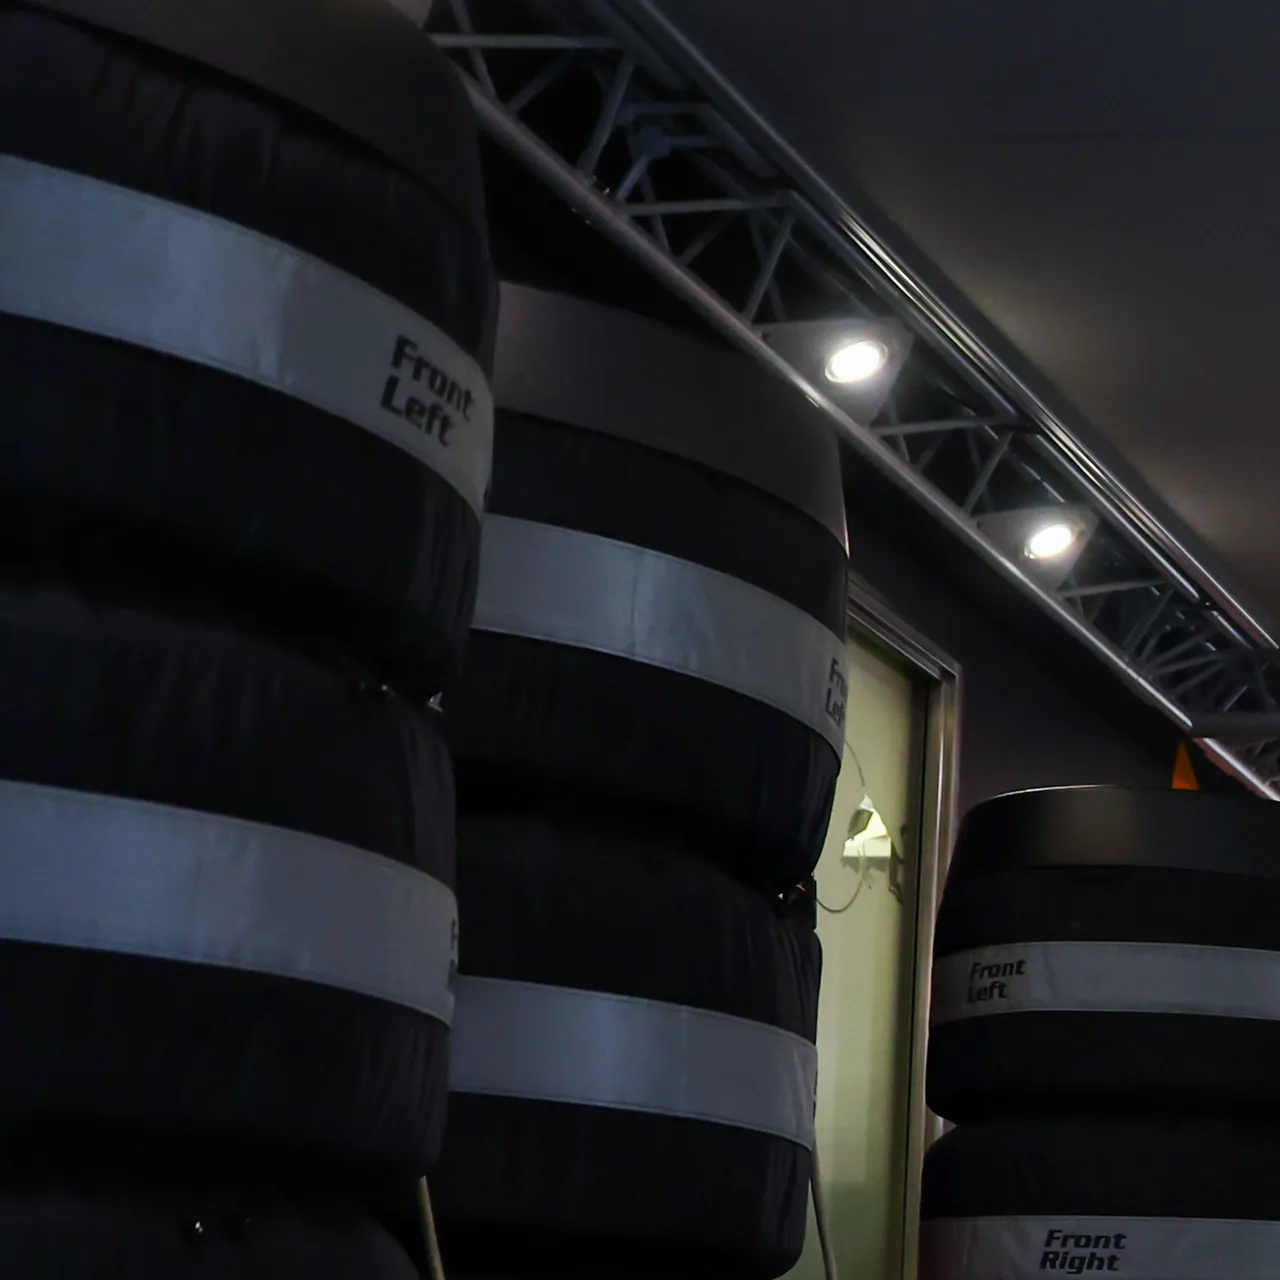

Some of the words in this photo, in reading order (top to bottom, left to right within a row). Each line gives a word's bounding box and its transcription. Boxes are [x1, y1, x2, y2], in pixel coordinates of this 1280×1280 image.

[391, 334, 473, 424] Front
[380, 373, 454, 447] Left
[969, 960, 1026, 980] Front
[967, 981, 1007, 1004] Left
[1044, 1229, 1128, 1251] Front
[1039, 1250, 1121, 1275] Right
